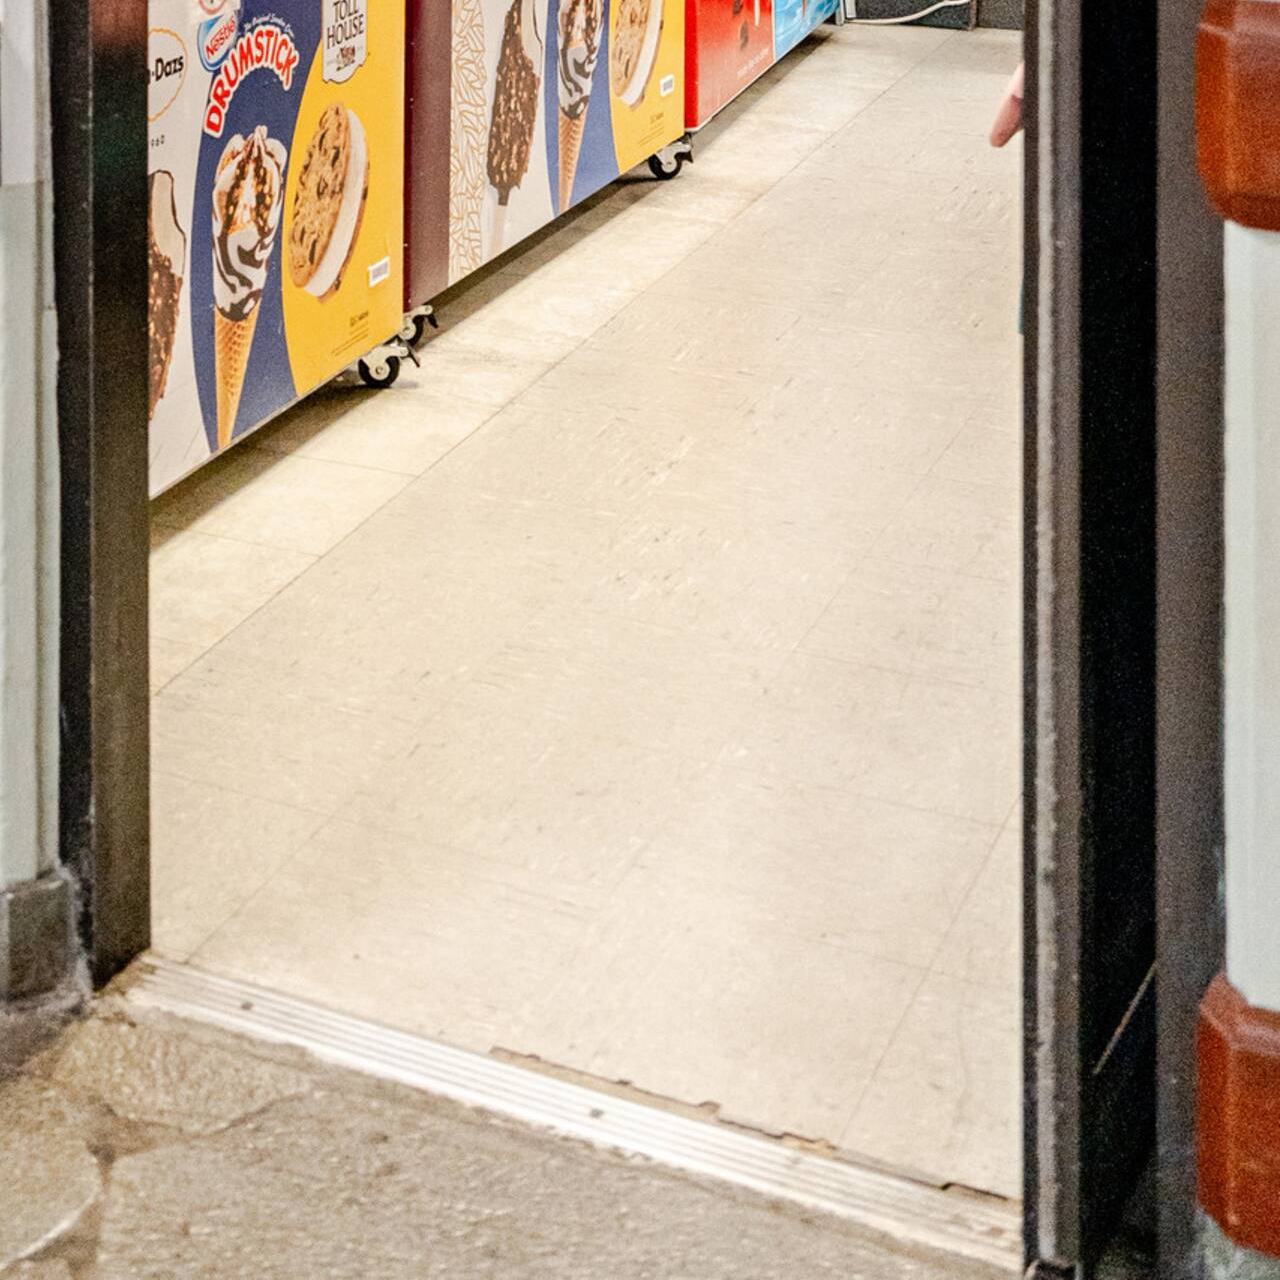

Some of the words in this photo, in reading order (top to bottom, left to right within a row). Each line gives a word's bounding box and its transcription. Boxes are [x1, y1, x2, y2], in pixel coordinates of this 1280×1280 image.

[205, 15, 236, 61] Nestlé
[326, 13, 364, 50] HOUSE
[203, 24, 300, 140] DRUMSTICK
